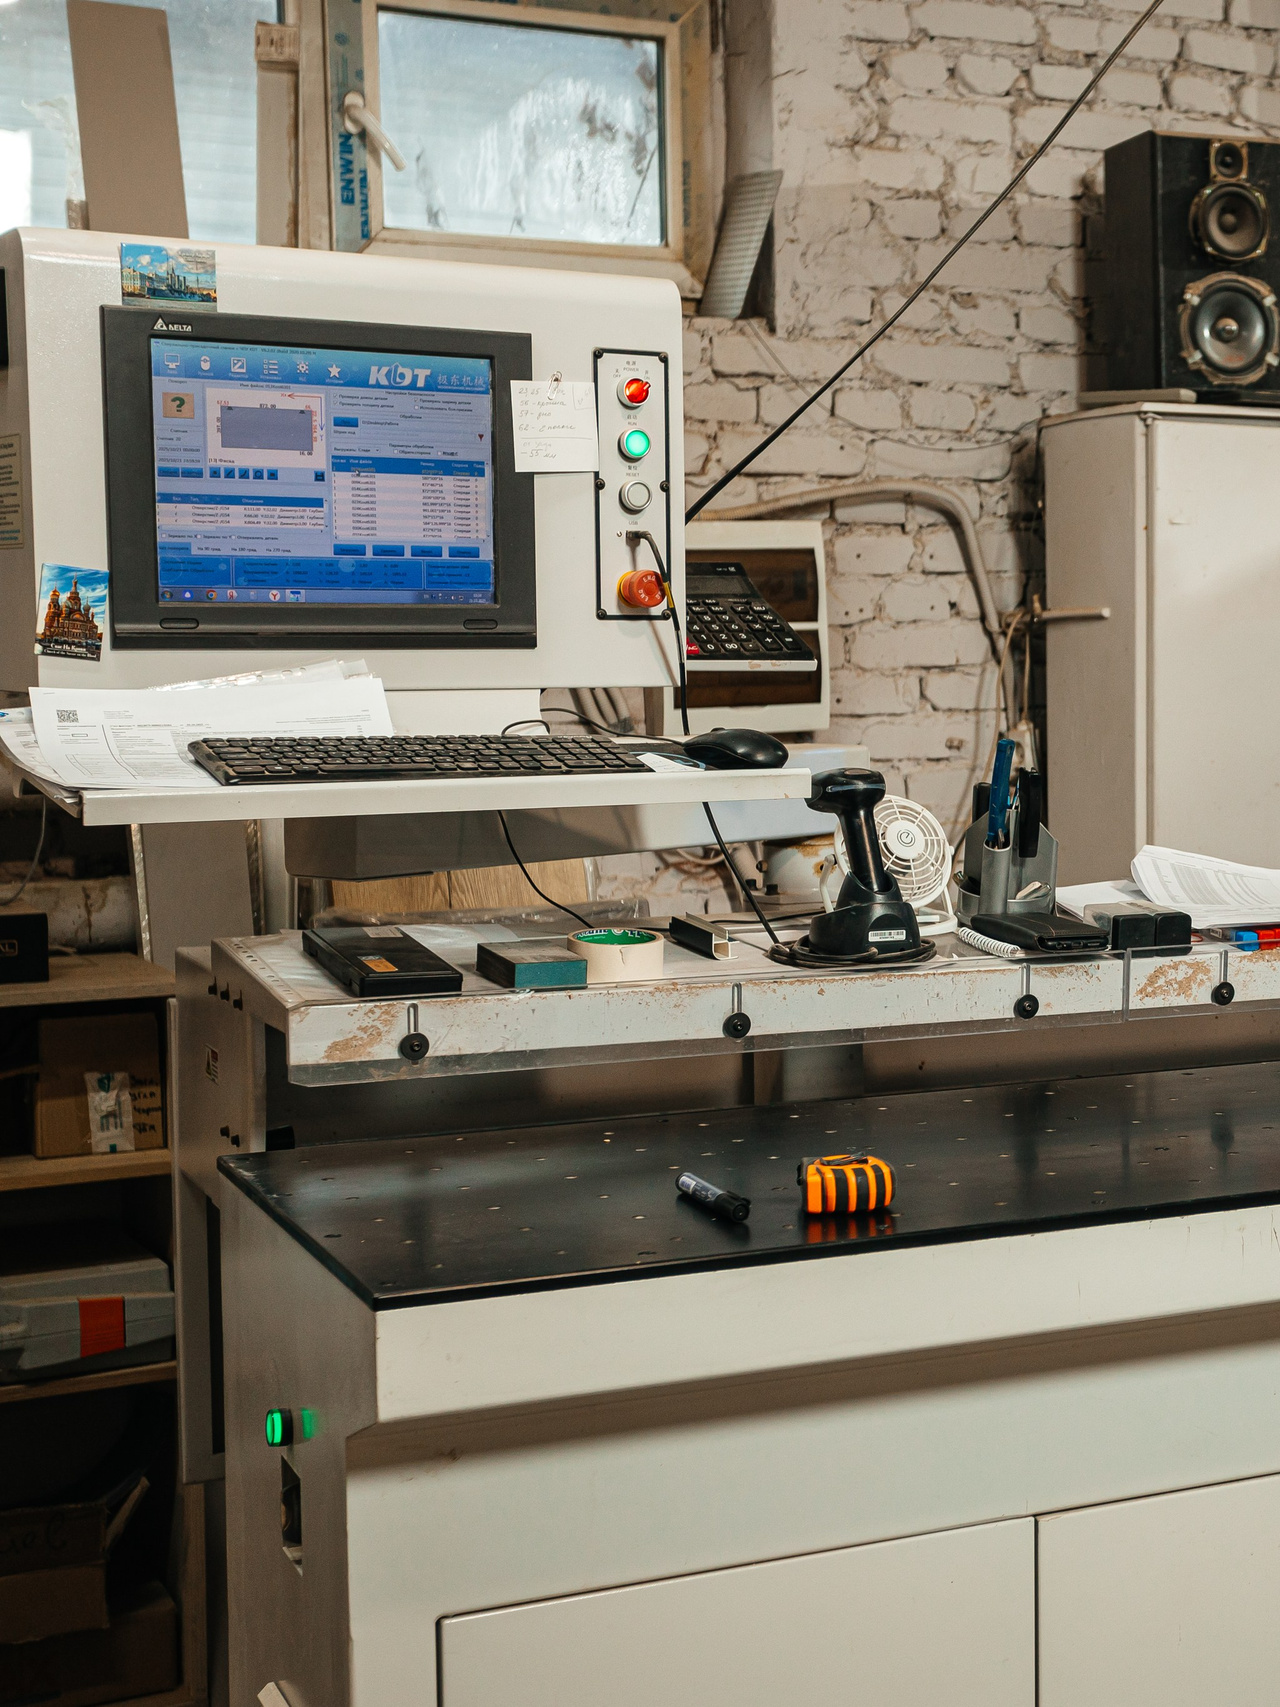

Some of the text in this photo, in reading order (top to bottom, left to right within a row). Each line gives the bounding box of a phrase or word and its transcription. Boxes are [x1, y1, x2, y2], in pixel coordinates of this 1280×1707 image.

[339, 133, 355, 205] ENWIN
[168, 323, 192, 332] DELTA
[368, 362, 431, 387] KDT
